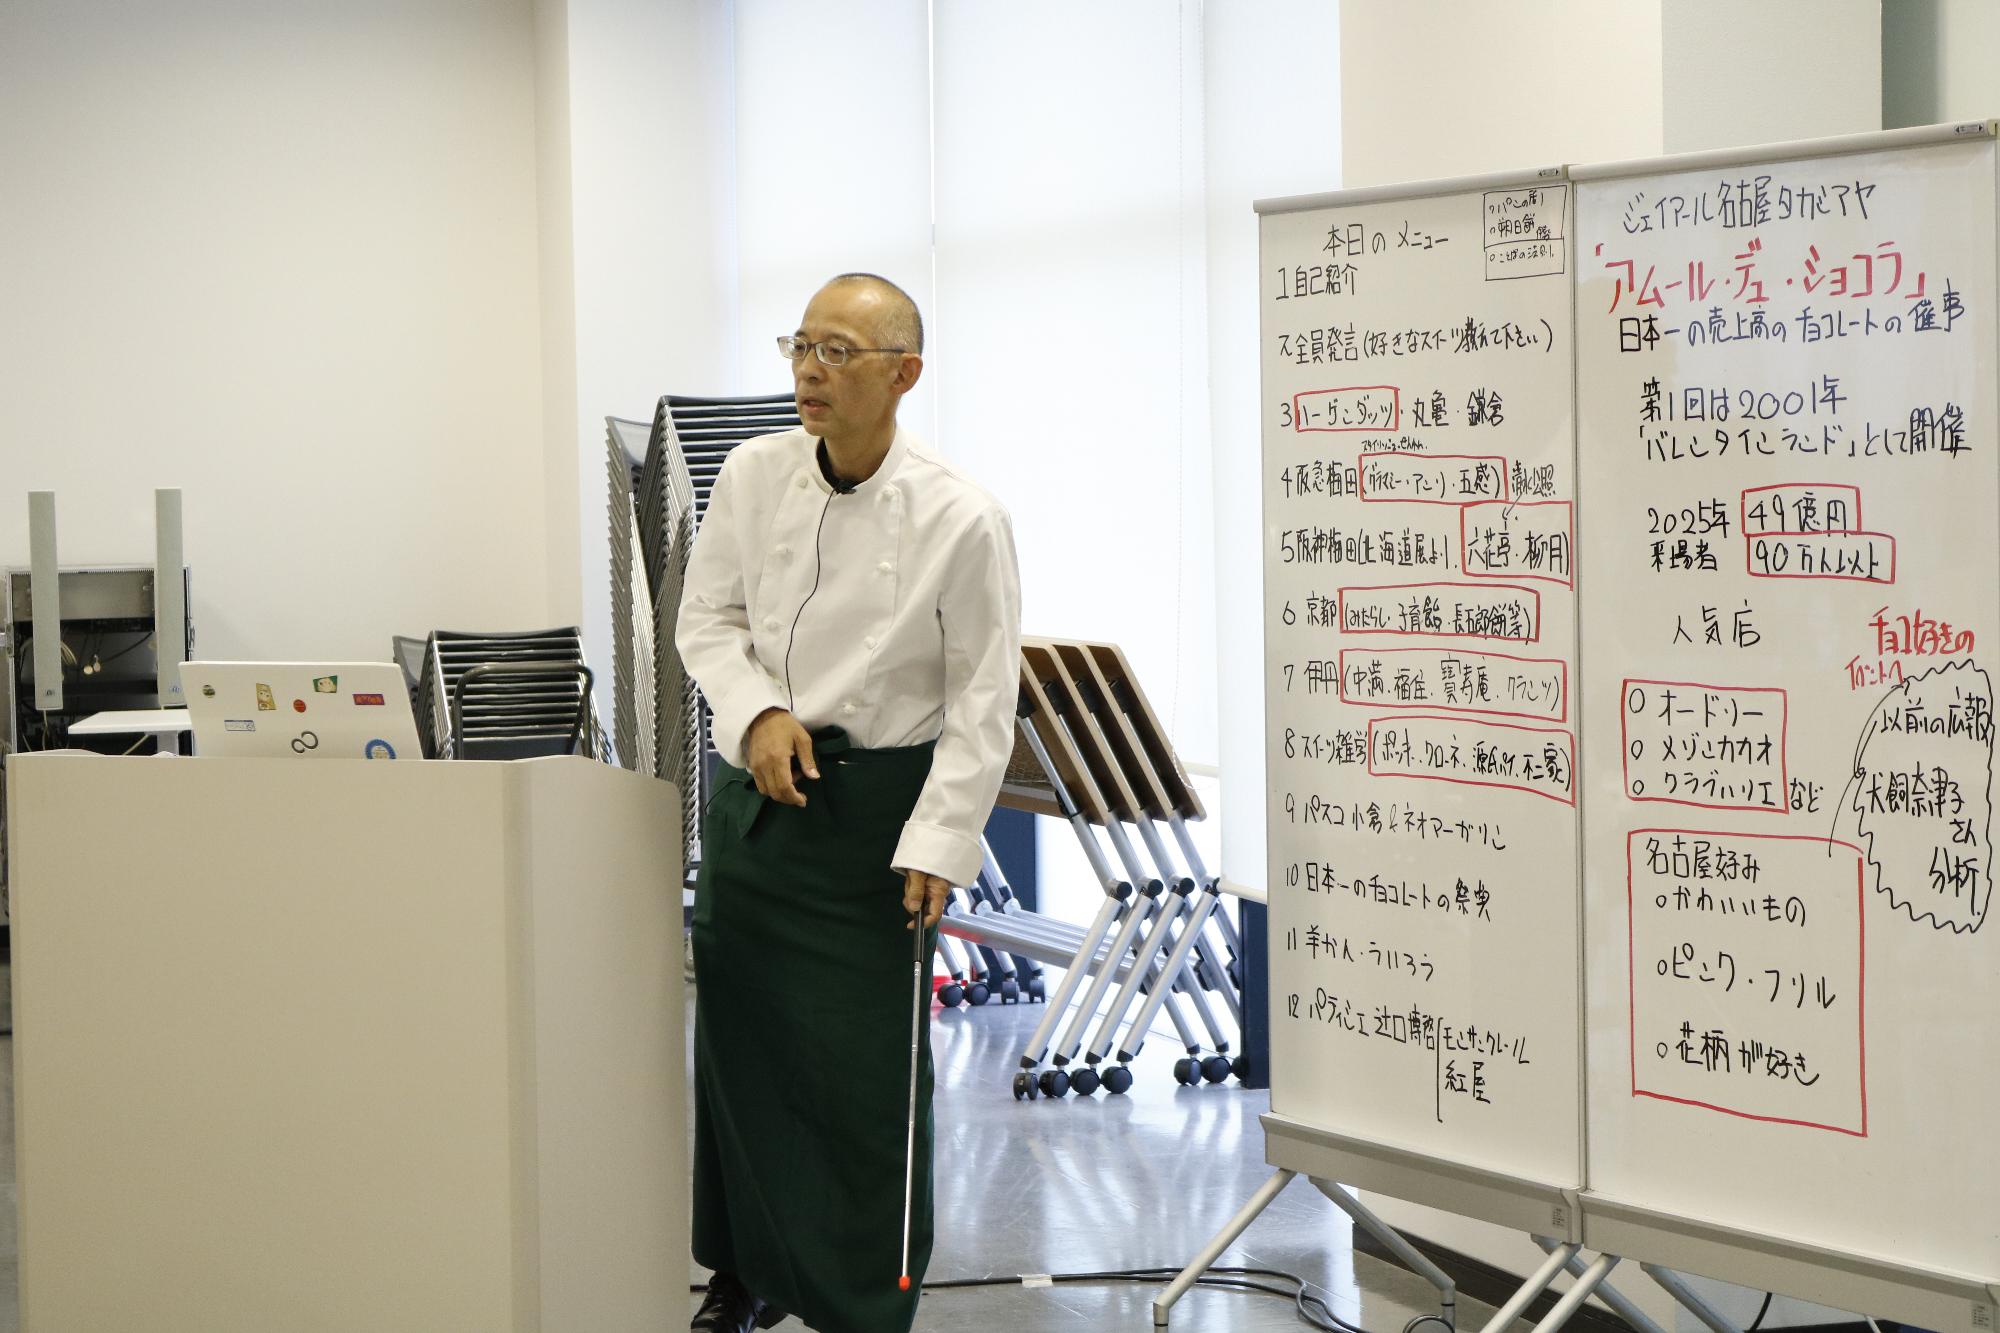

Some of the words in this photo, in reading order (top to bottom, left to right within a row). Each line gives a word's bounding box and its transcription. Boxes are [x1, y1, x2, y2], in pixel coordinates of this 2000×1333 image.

[1748, 491, 1848, 538] 49億円
[1755, 539, 1880, 581] 90万人以上
[1672, 598, 1761, 649] 人気店
[1645, 834, 1761, 883] 名古屋好み
